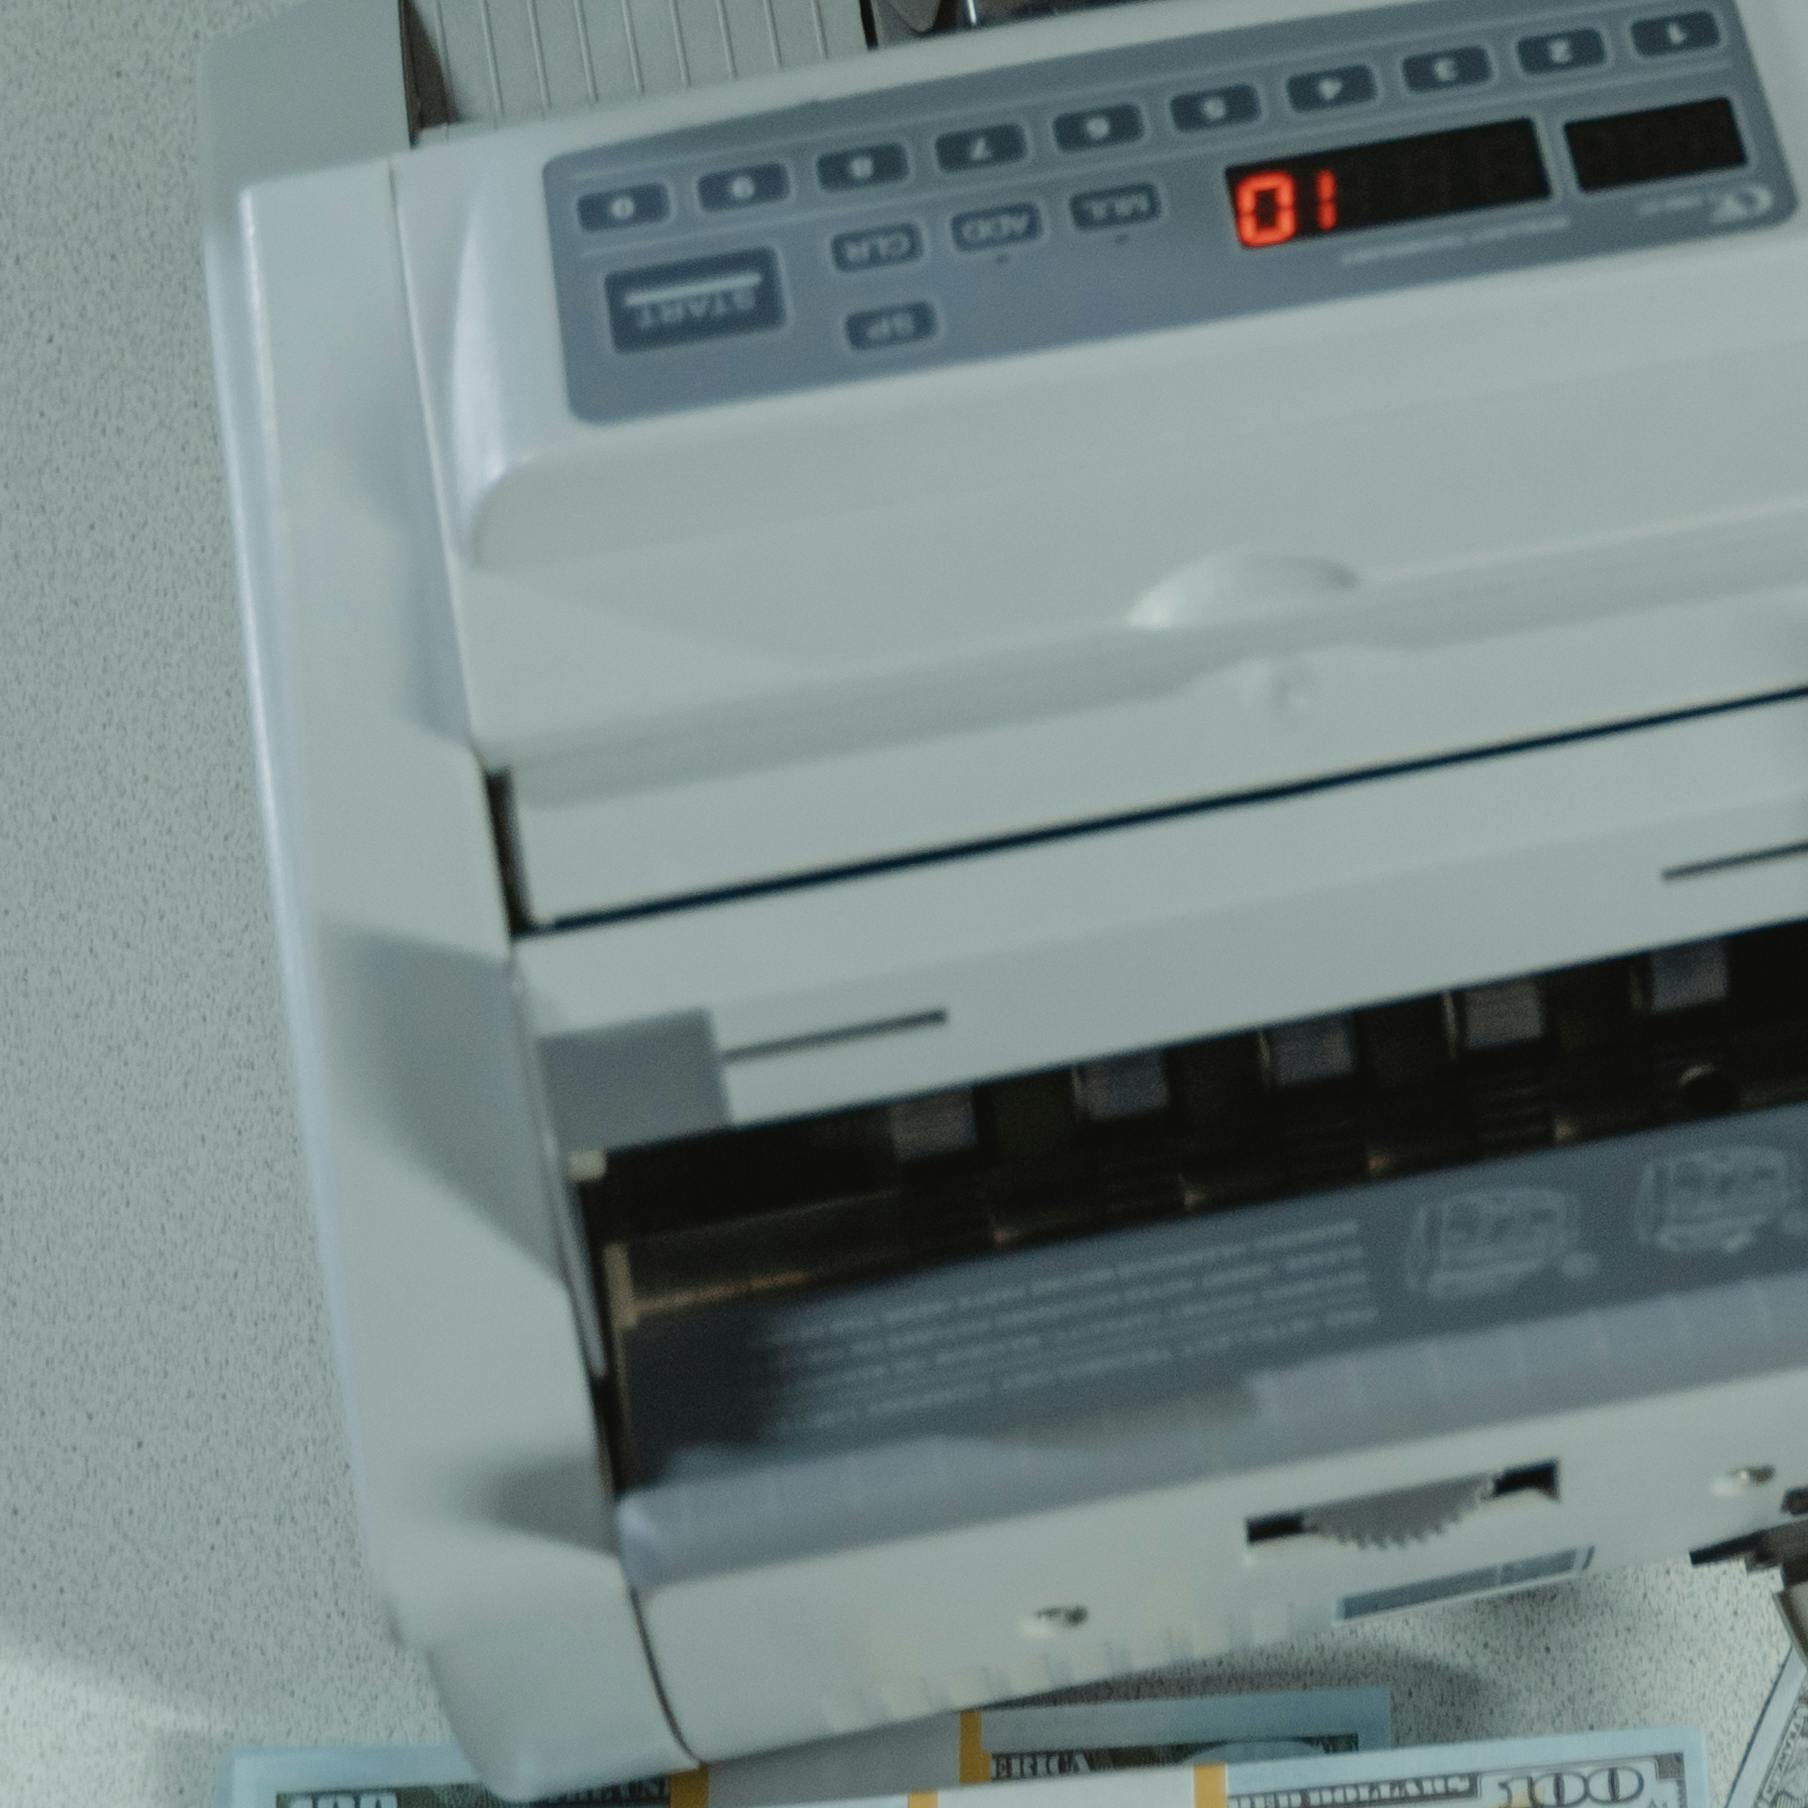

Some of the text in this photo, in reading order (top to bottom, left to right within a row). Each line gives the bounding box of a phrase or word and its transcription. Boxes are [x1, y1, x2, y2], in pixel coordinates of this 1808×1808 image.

[1668, 21, 1687, 45] 1
[1551, 39, 1570, 63] 2
[1434, 57, 1453, 83] 3
[1317, 77, 1343, 101] 4
[970, 137, 993, 159] 7
[1235, 169, 1340, 251] 10
[961, 213, 1031, 241] ADD
[842, 234, 911, 262] CLR
[633, 287, 757, 328] START
[866, 312, 915, 338] SP
[1495, 1765, 1645, 1808] 100
